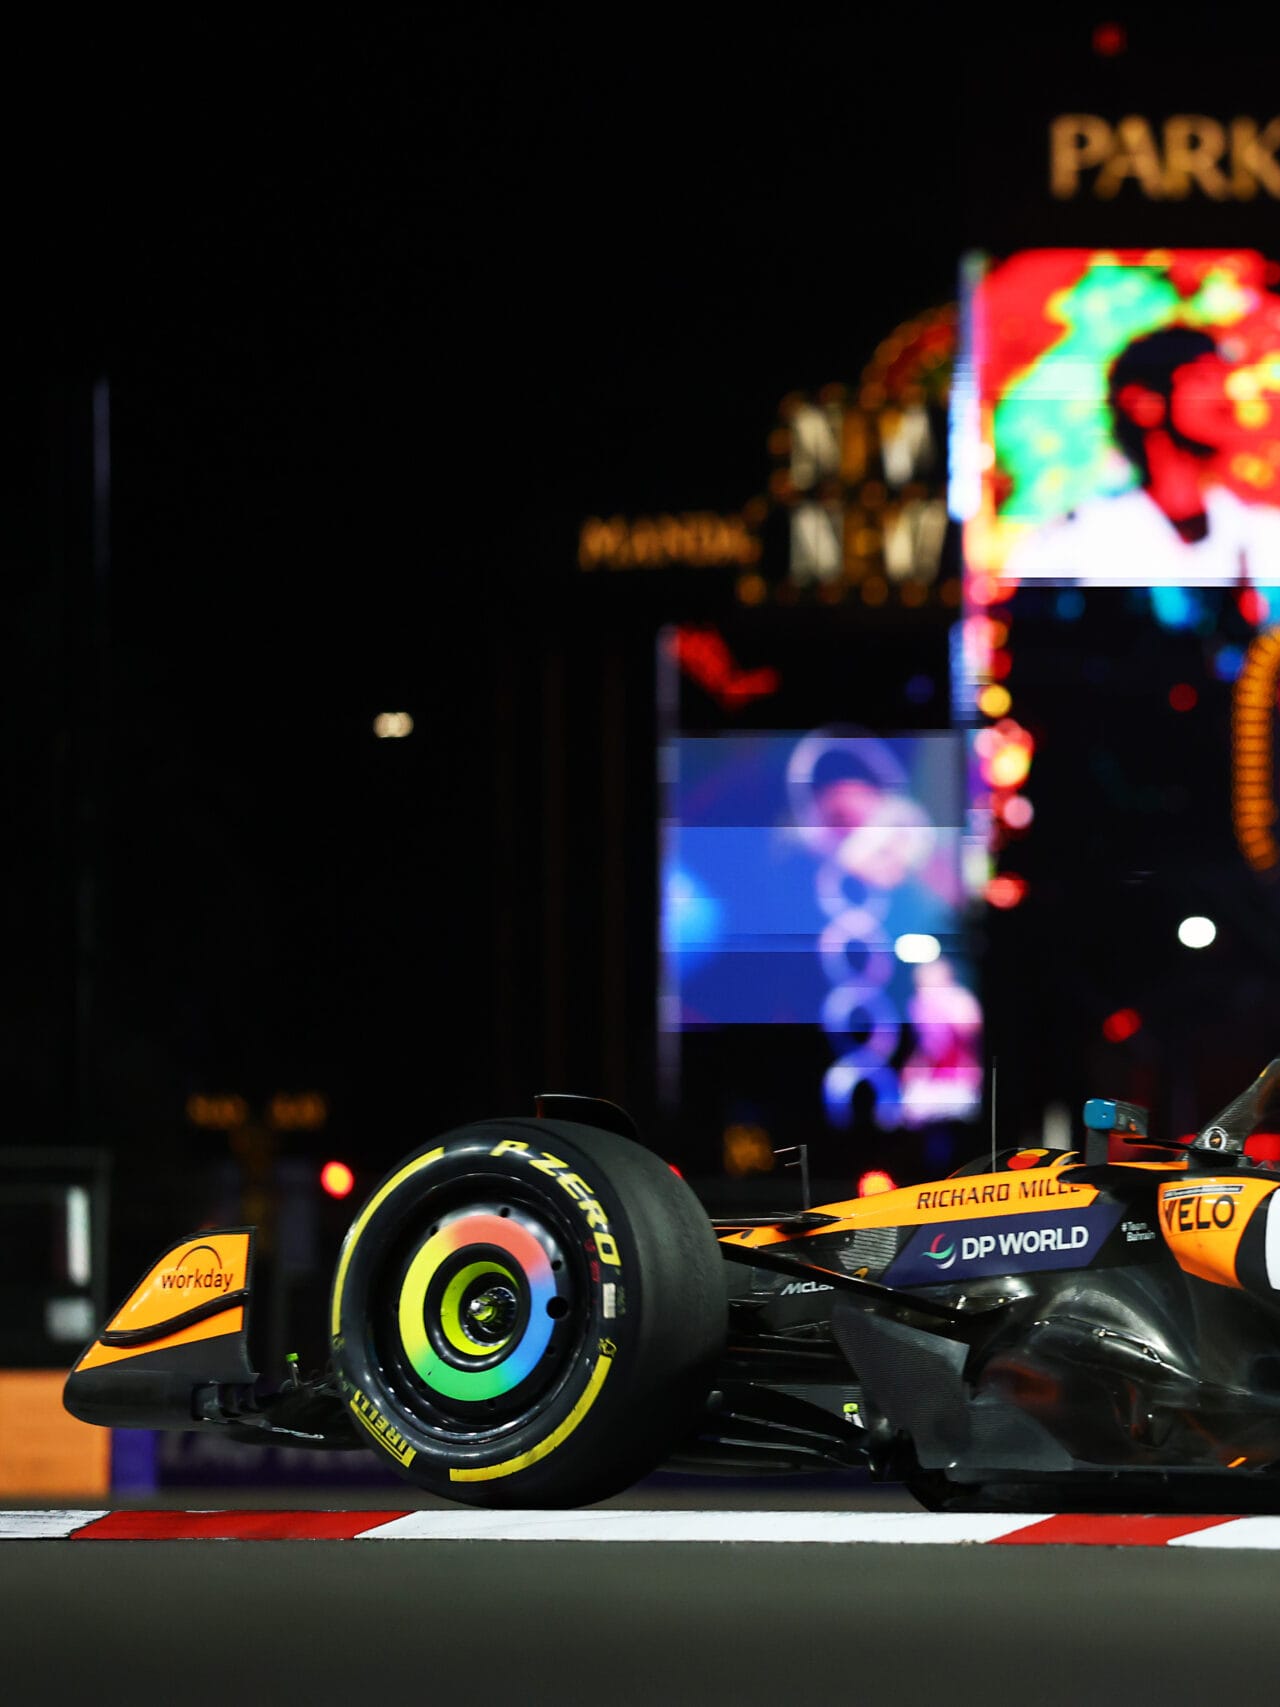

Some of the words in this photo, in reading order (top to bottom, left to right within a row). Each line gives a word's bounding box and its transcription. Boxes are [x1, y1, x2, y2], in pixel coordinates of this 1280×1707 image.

[489, 1140, 529, 1156] P
[528, 1152, 622, 1266] ZERO
[917, 1183, 1010, 1210] RICHARD
[1019, 1178, 1081, 1200] MILL
[1163, 1195, 1235, 1233] VELO
[962, 1236, 995, 1261] DP
[999, 1226, 1088, 1256] WORLD
[162, 1268, 233, 1292] workday
[350, 1389, 417, 1468] PIRELLI
